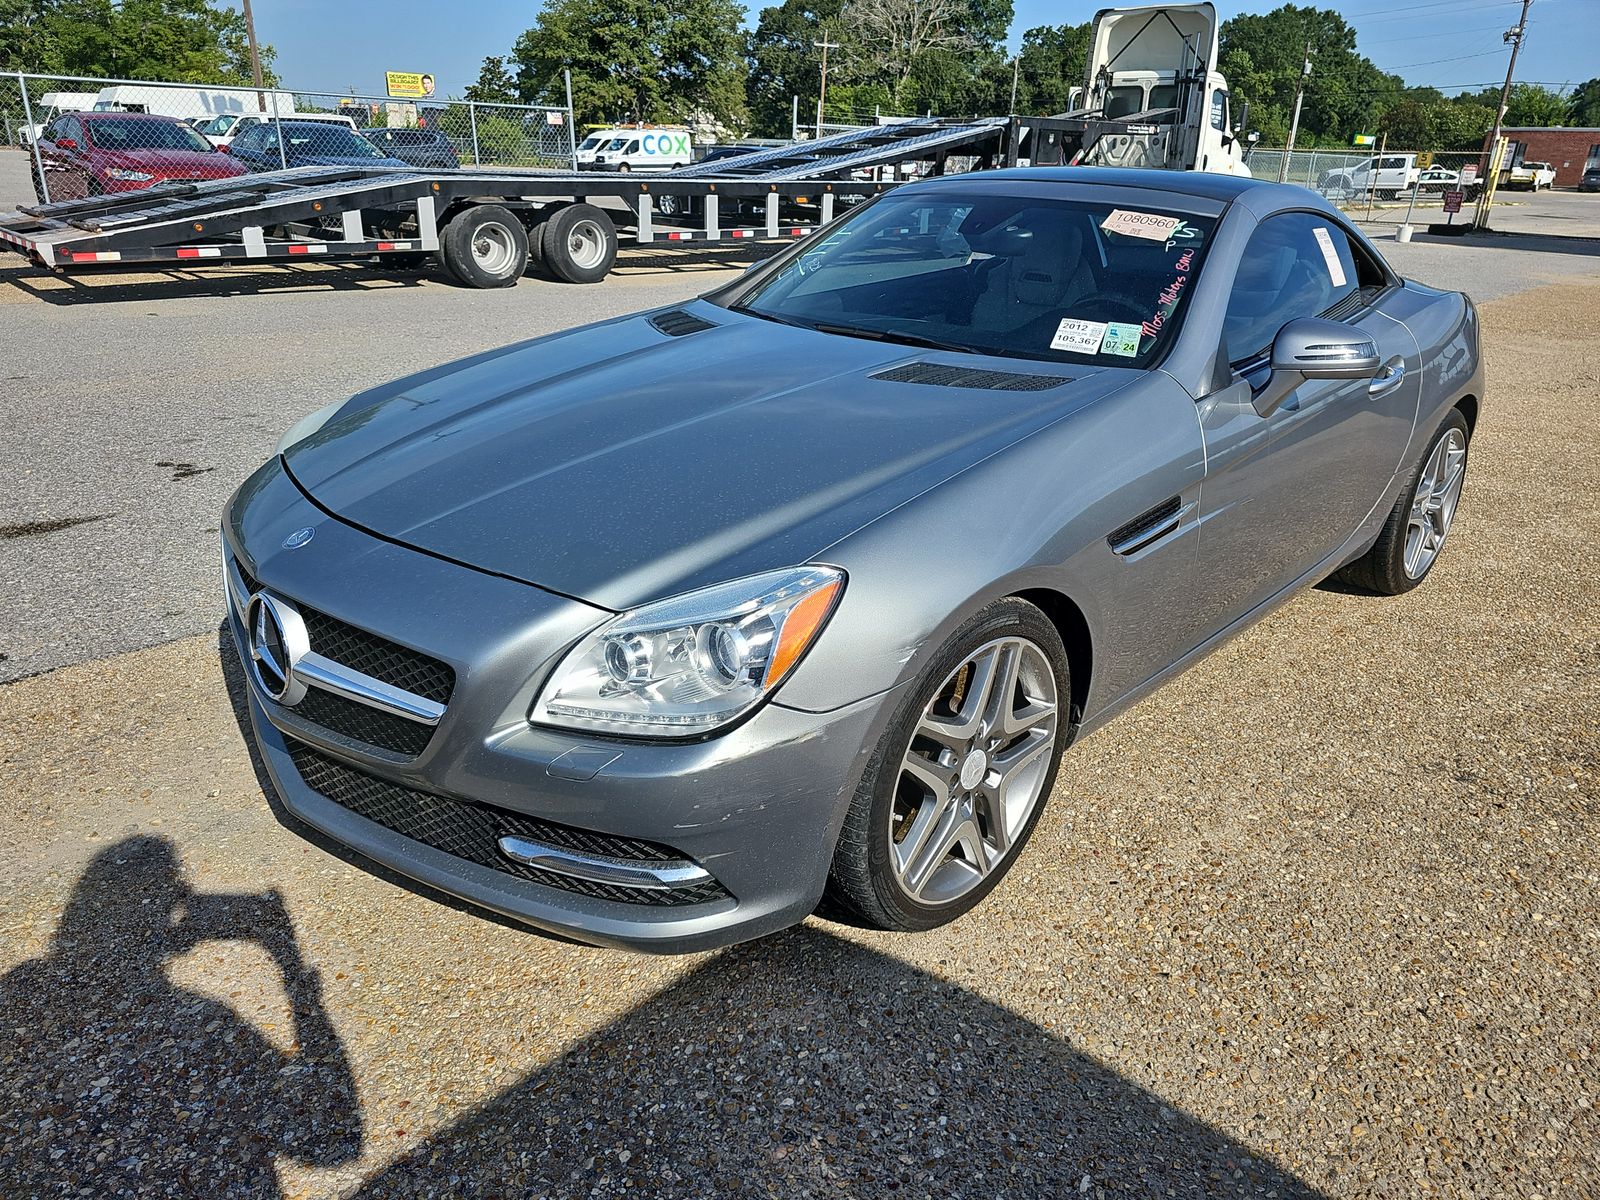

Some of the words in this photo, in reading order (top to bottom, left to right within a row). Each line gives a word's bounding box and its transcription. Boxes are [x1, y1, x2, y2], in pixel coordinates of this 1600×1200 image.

[643, 135, 688, 155] COX
[1420, 153, 1428, 162] 5
[1116, 213, 1176, 229] 1080960
[1140, 310, 1167, 338] Moss
[1157, 275, 1186, 306] Motors
[1175, 248, 1194, 272] BMW
[1062, 322, 1089, 332] 2012
[1105, 340, 1118, 350] 07
[1122, 343, 1135, 352] 24
